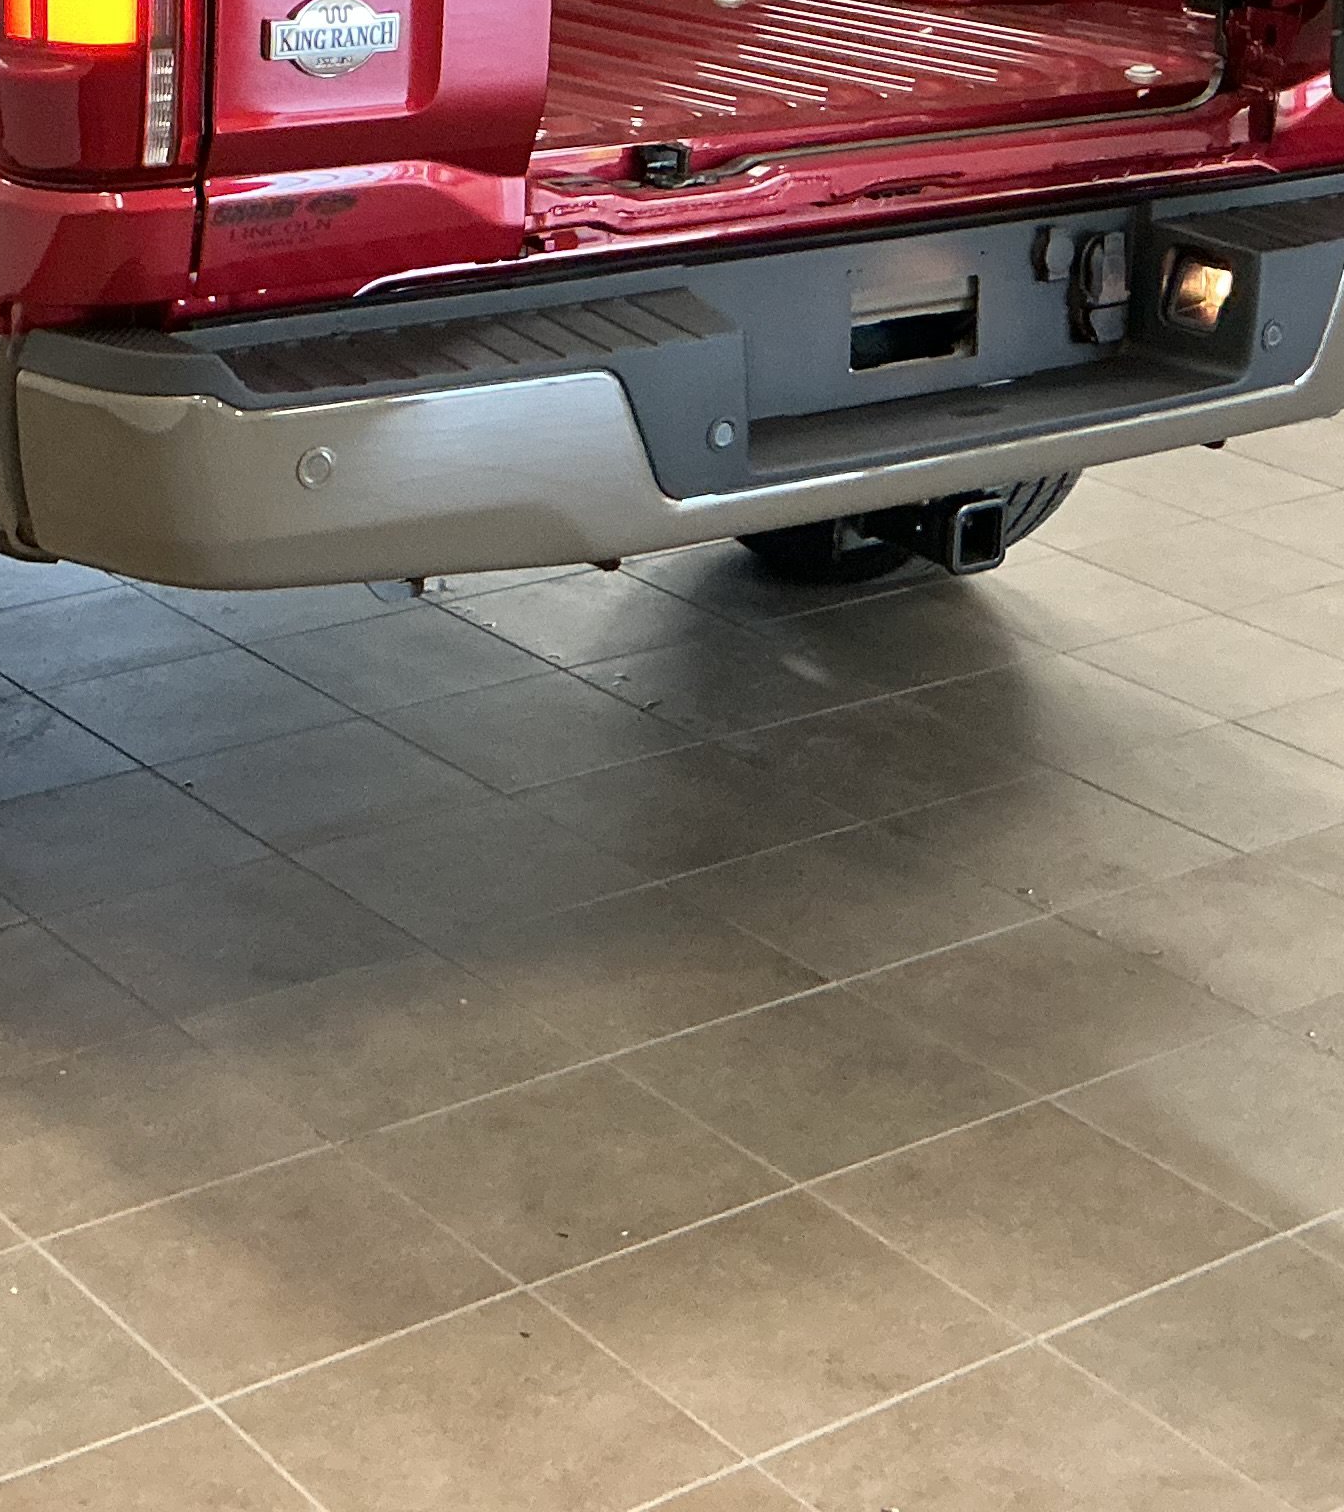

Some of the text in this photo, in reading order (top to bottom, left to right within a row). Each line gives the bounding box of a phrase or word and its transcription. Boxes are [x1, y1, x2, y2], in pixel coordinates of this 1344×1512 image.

[279, 20, 394, 52] KING RANCH
[229, 219, 333, 242] LINCOLN
